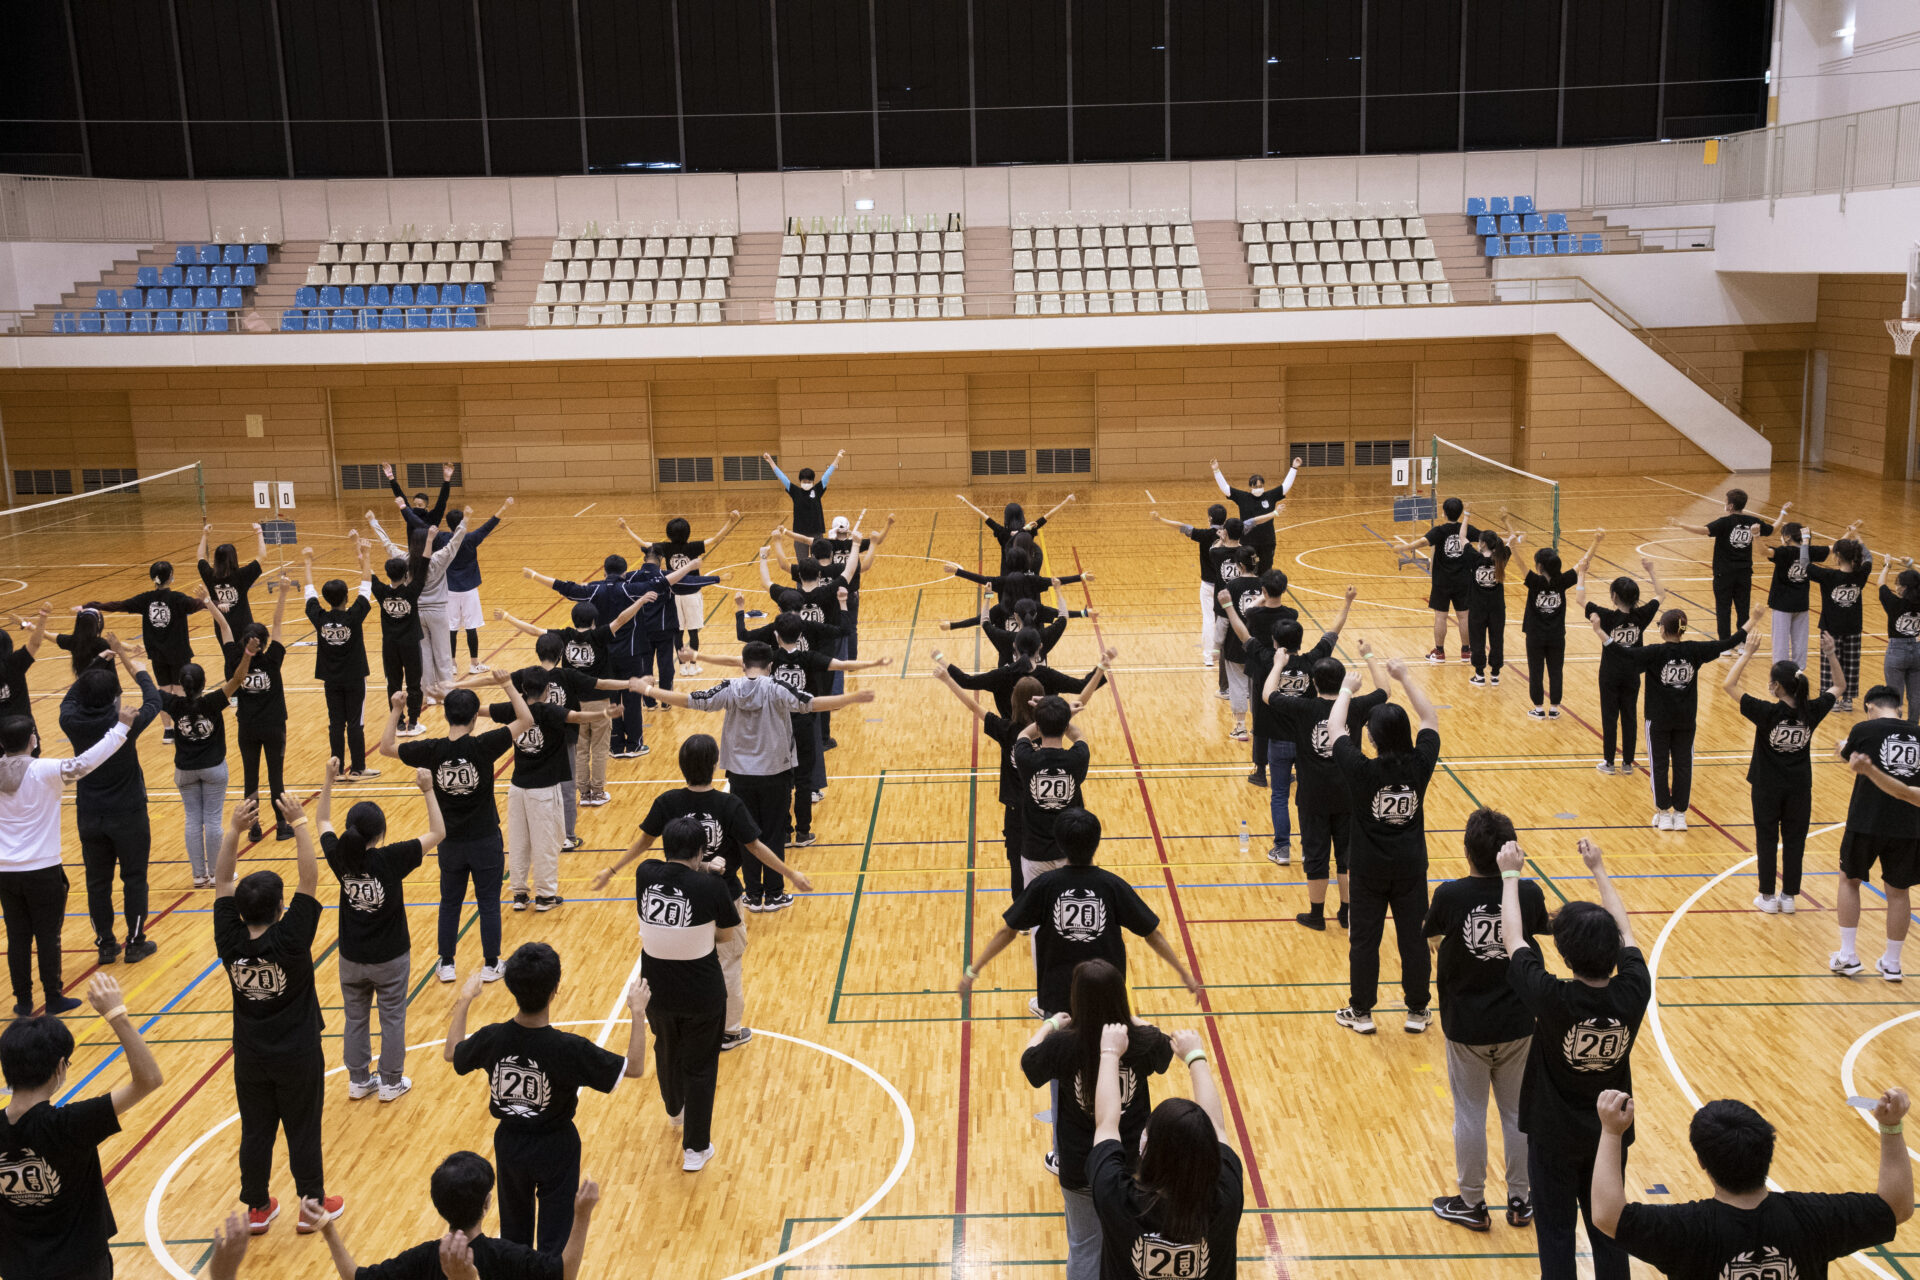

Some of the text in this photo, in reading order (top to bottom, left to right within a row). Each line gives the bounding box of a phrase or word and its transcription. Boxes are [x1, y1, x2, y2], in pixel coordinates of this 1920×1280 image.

[1397, 470, 1403, 481] 0
[259, 493, 265, 504] 0
[283, 493, 290, 504] 0
[1736, 530, 1749, 540] 20
[219, 590, 233, 601] 20
[1540, 596, 1556, 606] 20
[1839, 590, 1855, 601] 20
[390, 601, 406, 612] 20
[802, 611, 818, 621] 20
[1617, 631, 1634, 643] 20
[571, 647, 589, 661] 20
[245, 675, 264, 688] 20
[781, 672, 800, 688] 20
[1669, 668, 1687, 682] 20
[1282, 680, 1303, 690] 20
[1778, 730, 1803, 744] 20
[1891, 745, 1916, 765] 20
[446, 769, 470, 786] 20
[1040, 780, 1067, 798] 20
[1383, 796, 1409, 814] 20
[350, 883, 374, 902] 20
[649, 898, 680, 926] 20
[1065, 904, 1095, 927] 20
[241, 968, 274, 989] 20
[1578, 1033, 1618, 1057] 20
[503, 1072, 538, 1100] 20
[0, 1165, 44, 1193] 20
[1149, 1248, 1195, 1277] 20
